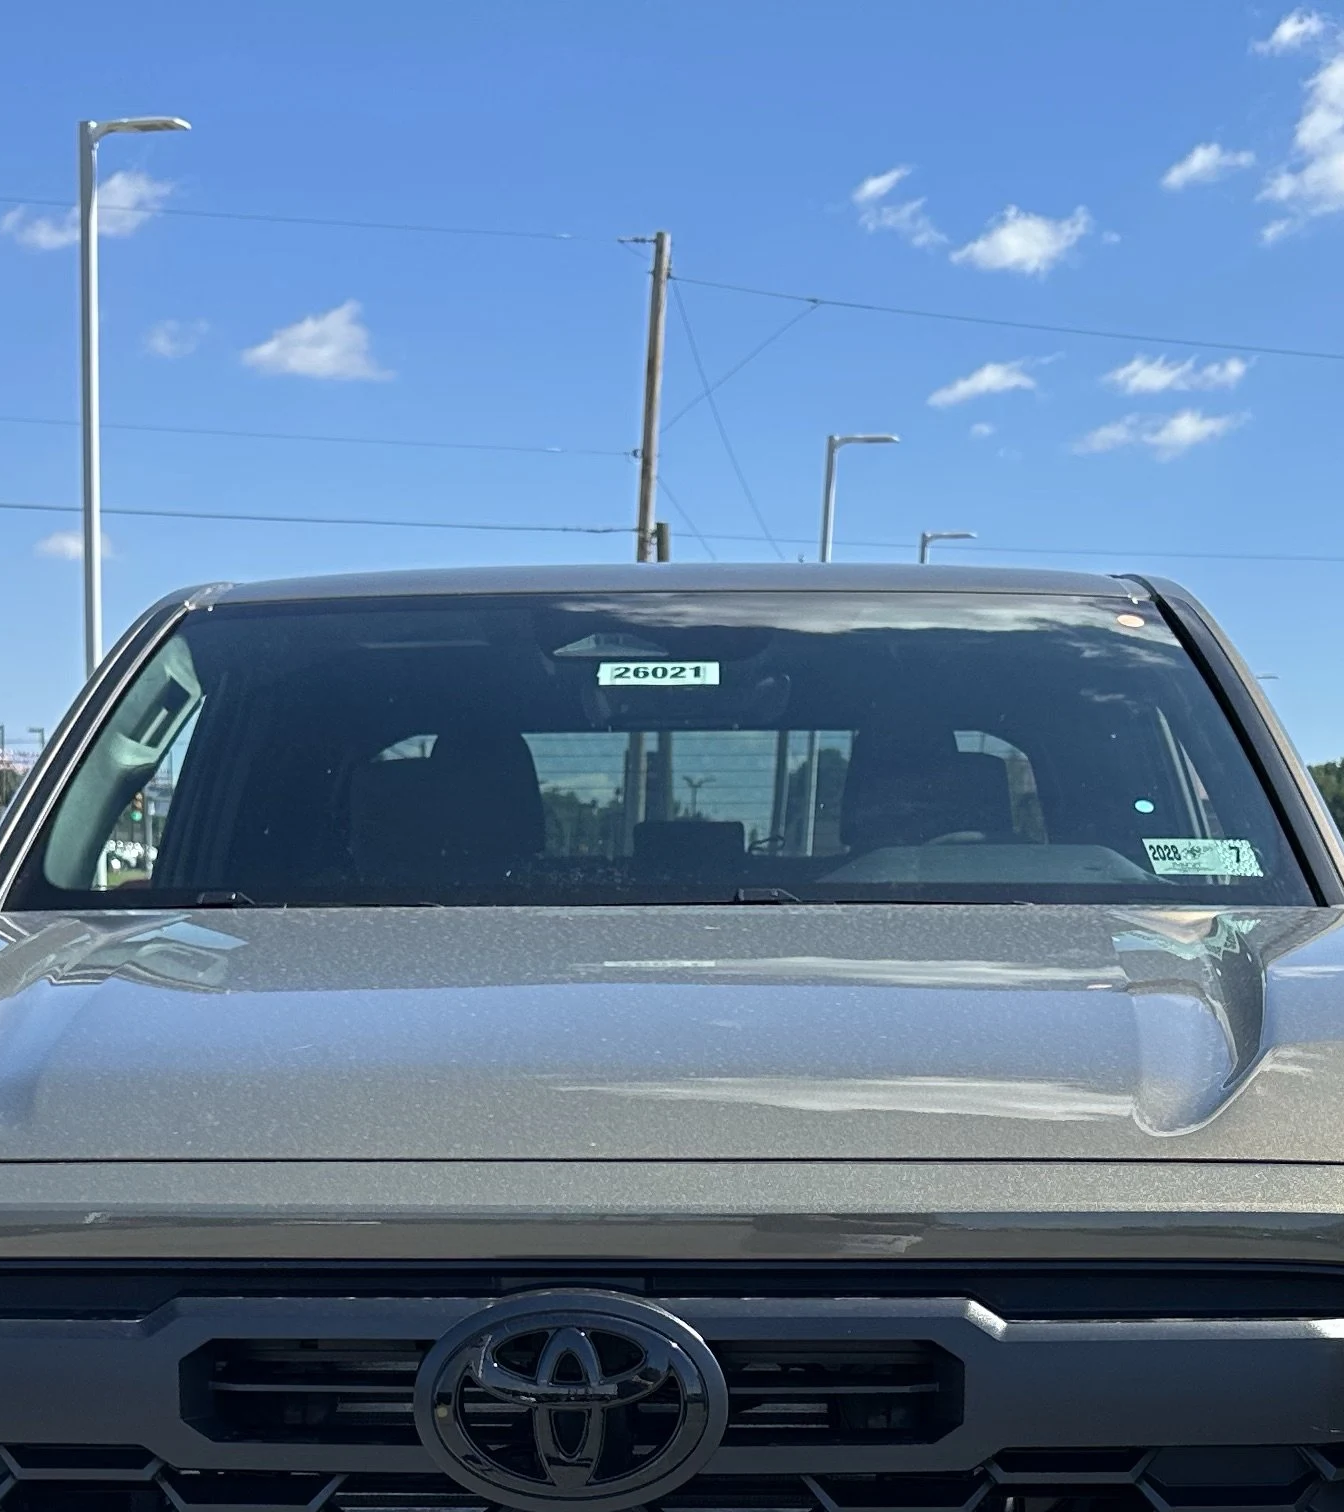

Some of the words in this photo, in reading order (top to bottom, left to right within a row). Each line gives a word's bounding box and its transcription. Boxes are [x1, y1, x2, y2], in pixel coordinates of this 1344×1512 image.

[614, 665, 702, 679] 26021
[1148, 844, 1182, 861] 2028
[1229, 845, 1242, 863] 7
